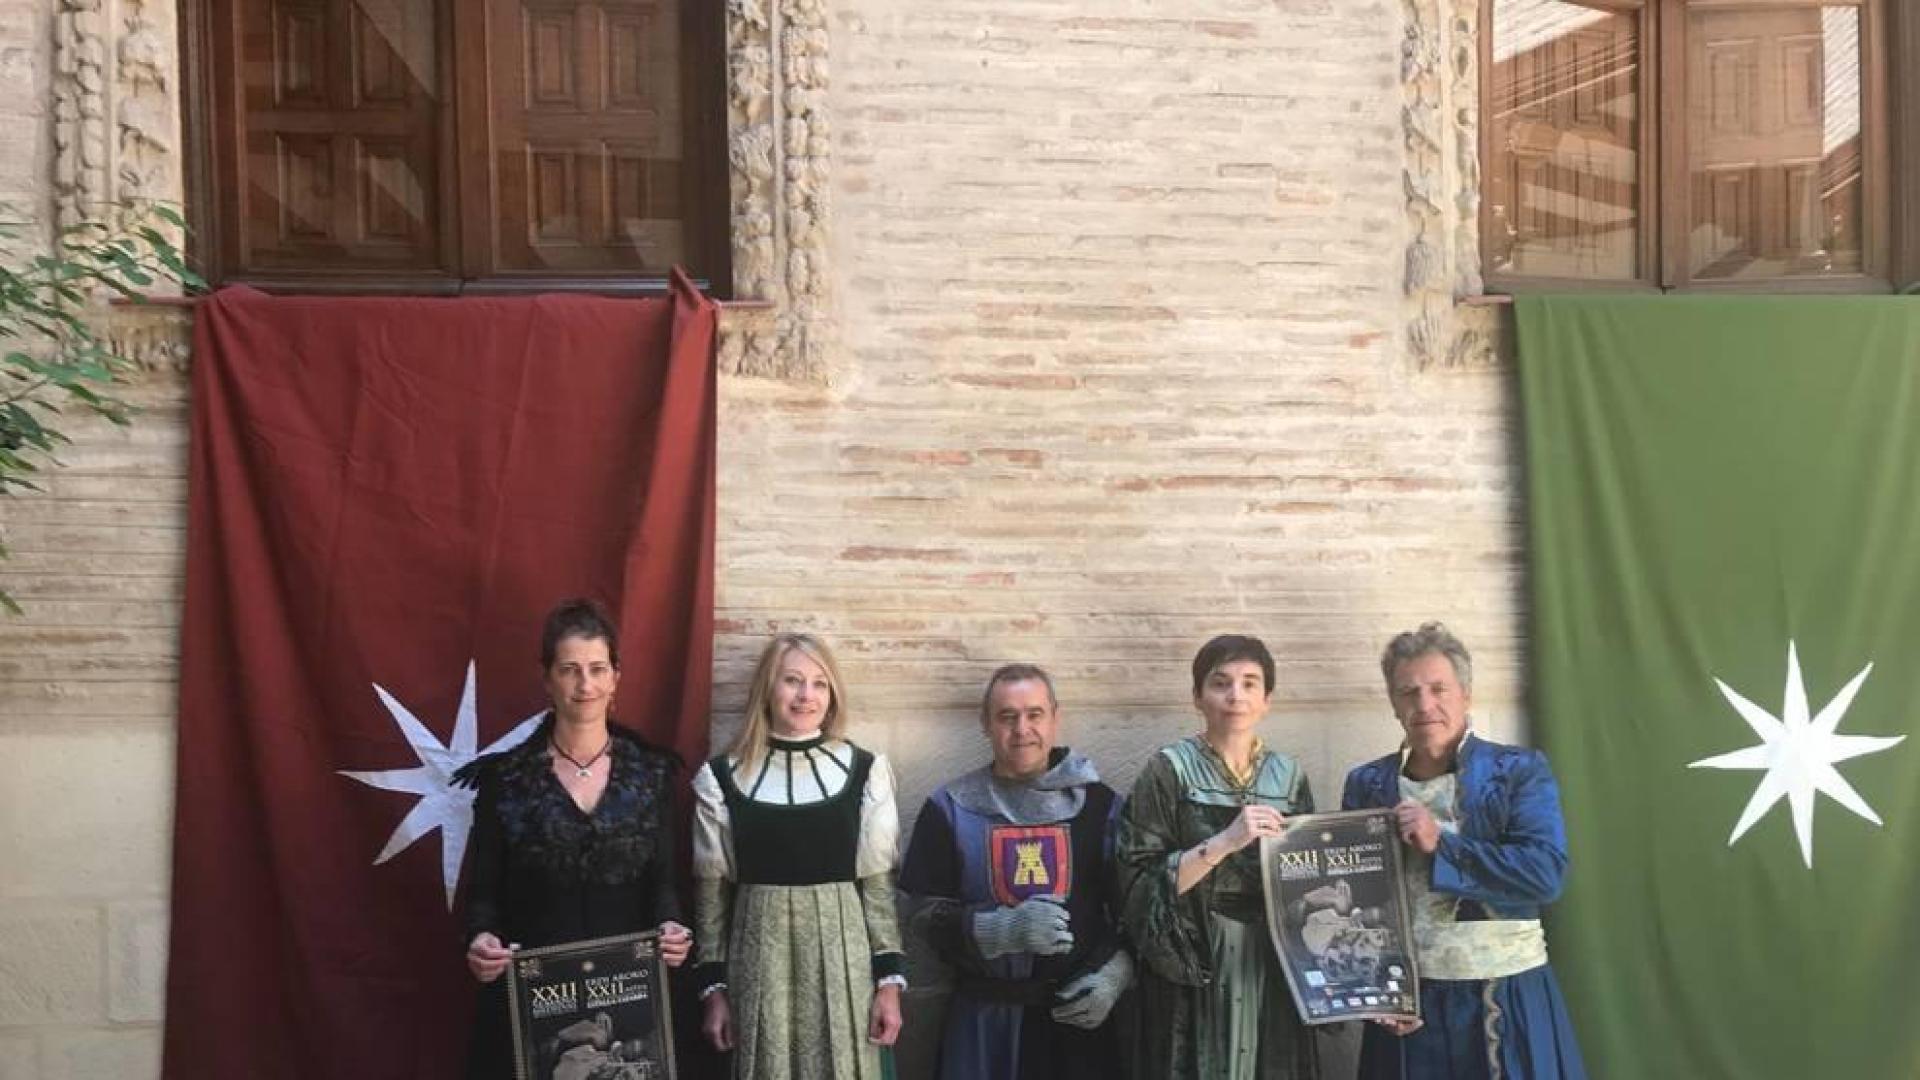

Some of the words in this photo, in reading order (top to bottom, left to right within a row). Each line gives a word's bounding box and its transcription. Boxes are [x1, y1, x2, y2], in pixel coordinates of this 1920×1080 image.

[1280, 850, 1318, 866] XXII
[1327, 852, 1360, 866] XXII
[532, 981, 576, 1001] XXII
[587, 981, 623, 999] XXII
